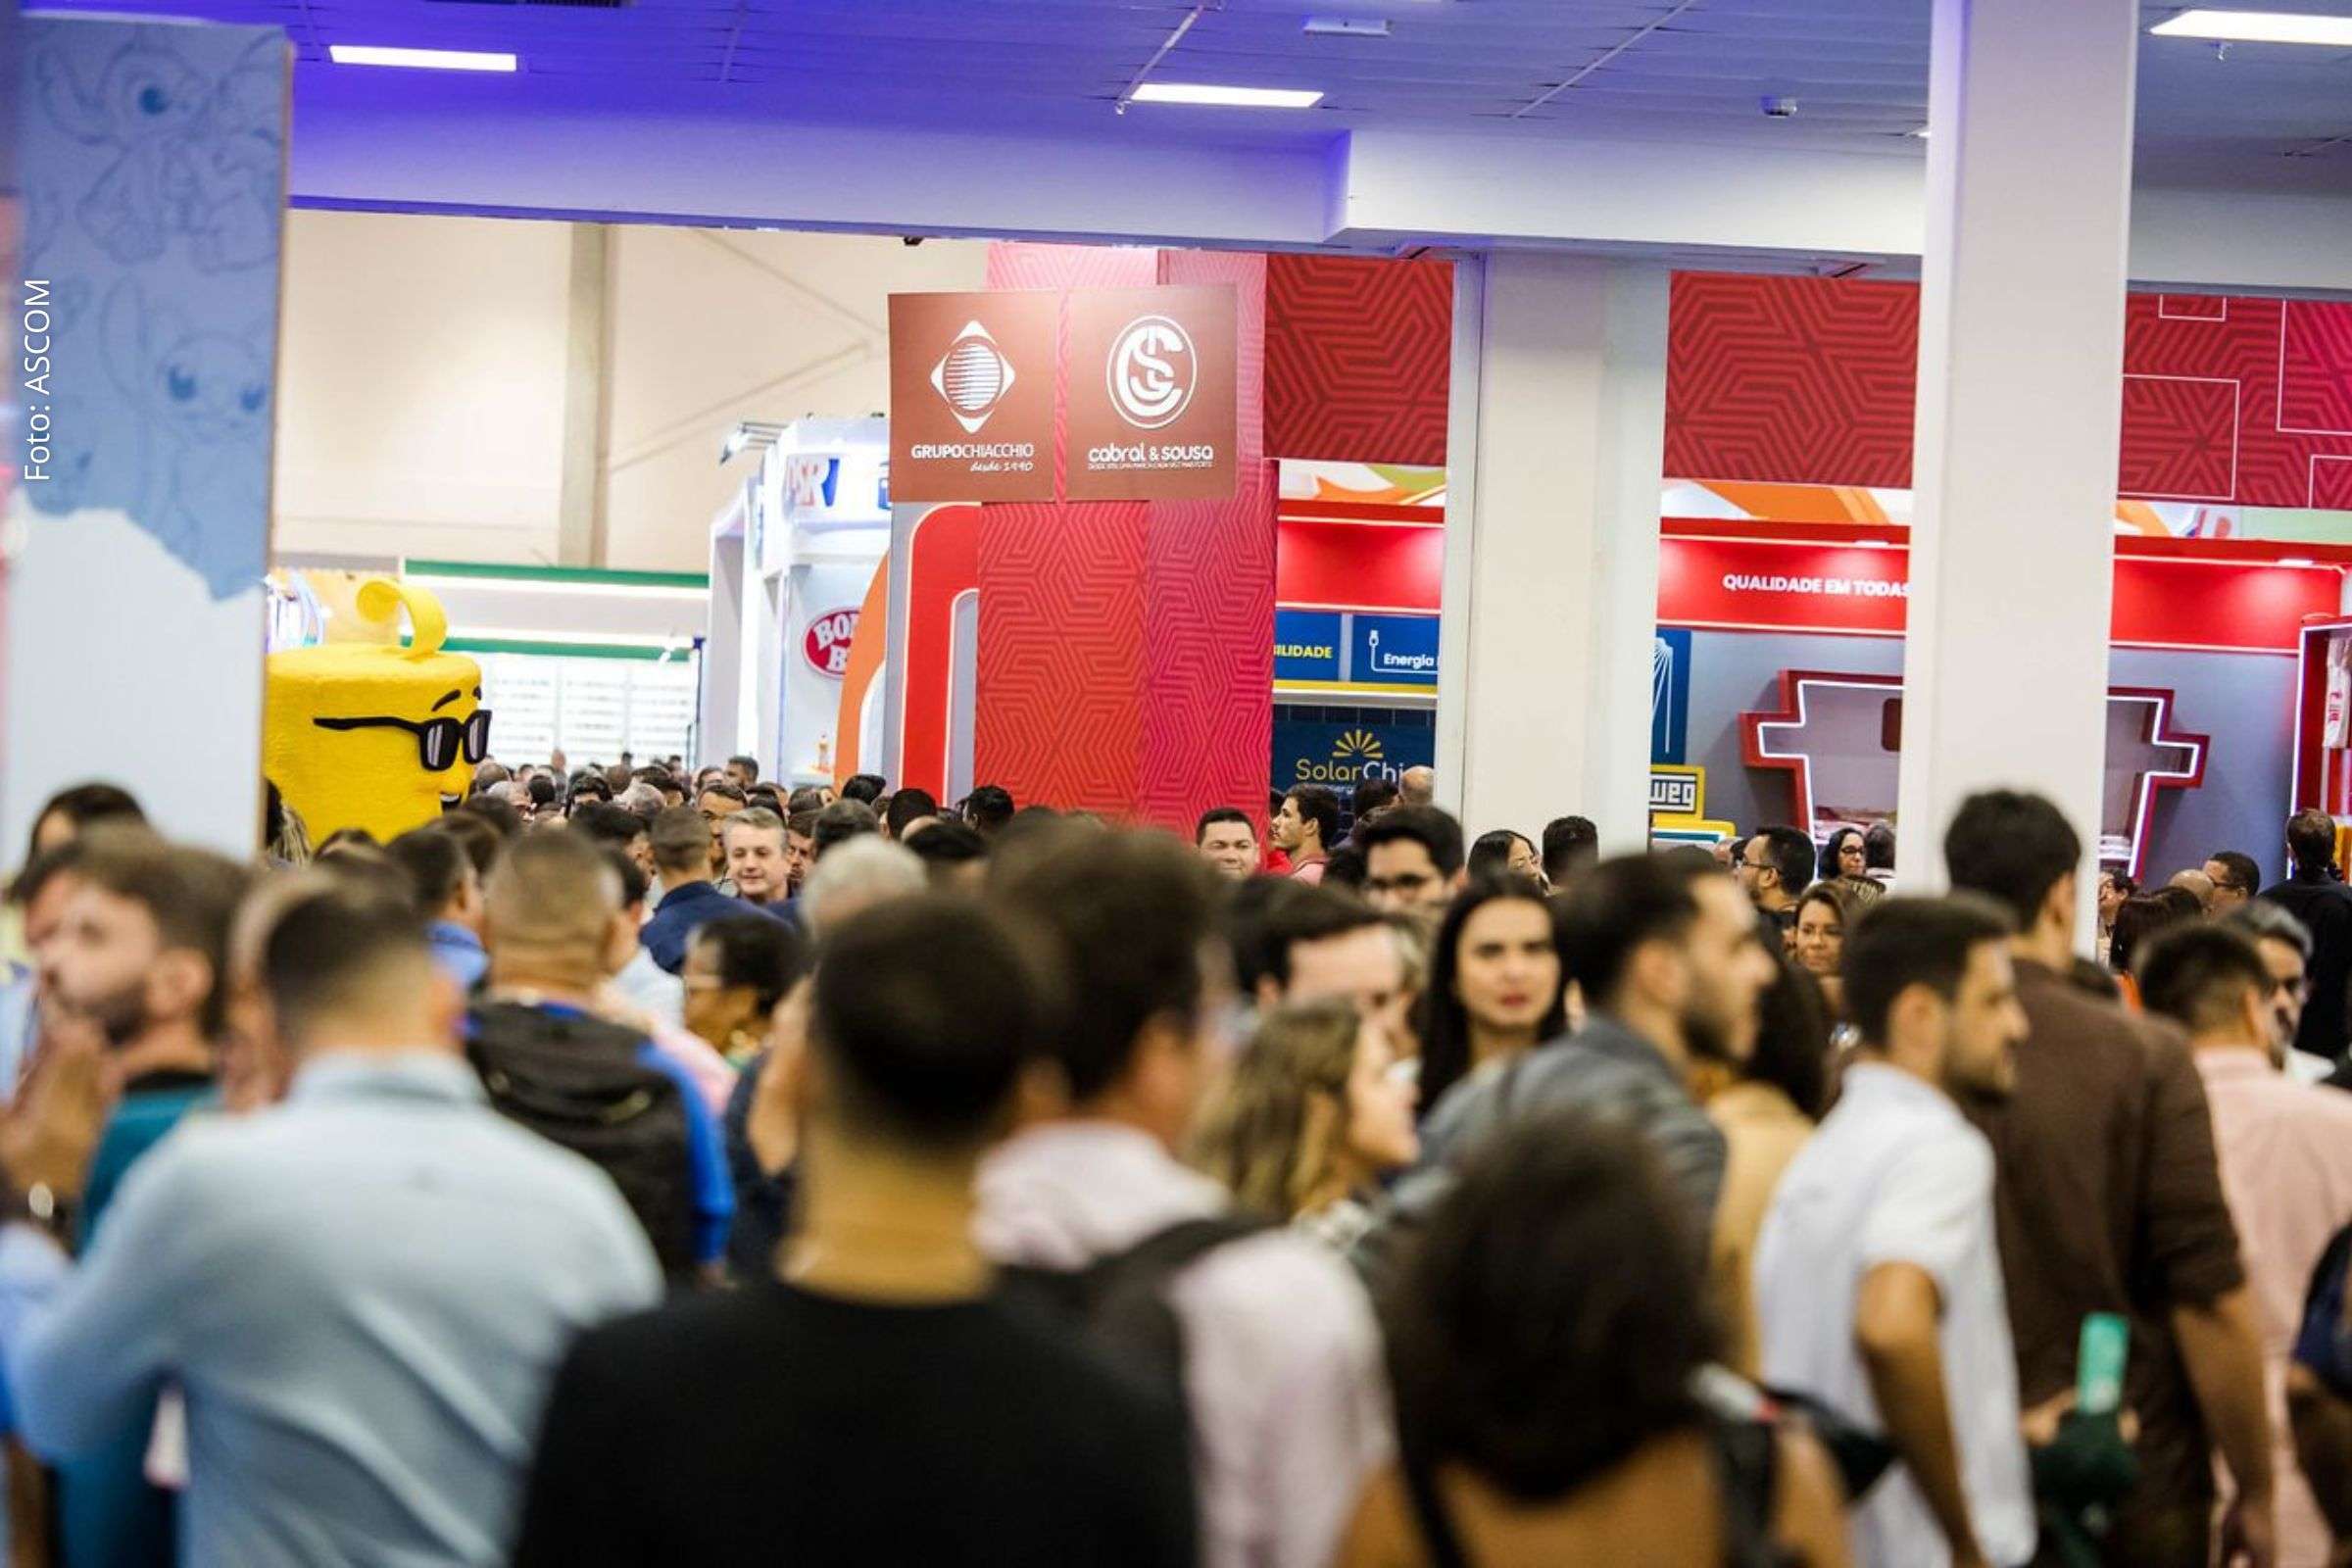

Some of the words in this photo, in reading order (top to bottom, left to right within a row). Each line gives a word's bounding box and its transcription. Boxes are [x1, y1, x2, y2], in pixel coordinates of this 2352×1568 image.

[1088, 441, 1146, 463] cabral
[1148, 446, 1159, 462] &
[1160, 445, 1214, 462] sousa
[1722, 574, 1822, 594] QUALIDADE
[1824, 579, 1851, 594] EM
[1273, 644, 1333, 659] ILIDADE
[1384, 653, 1435, 670] Energia
